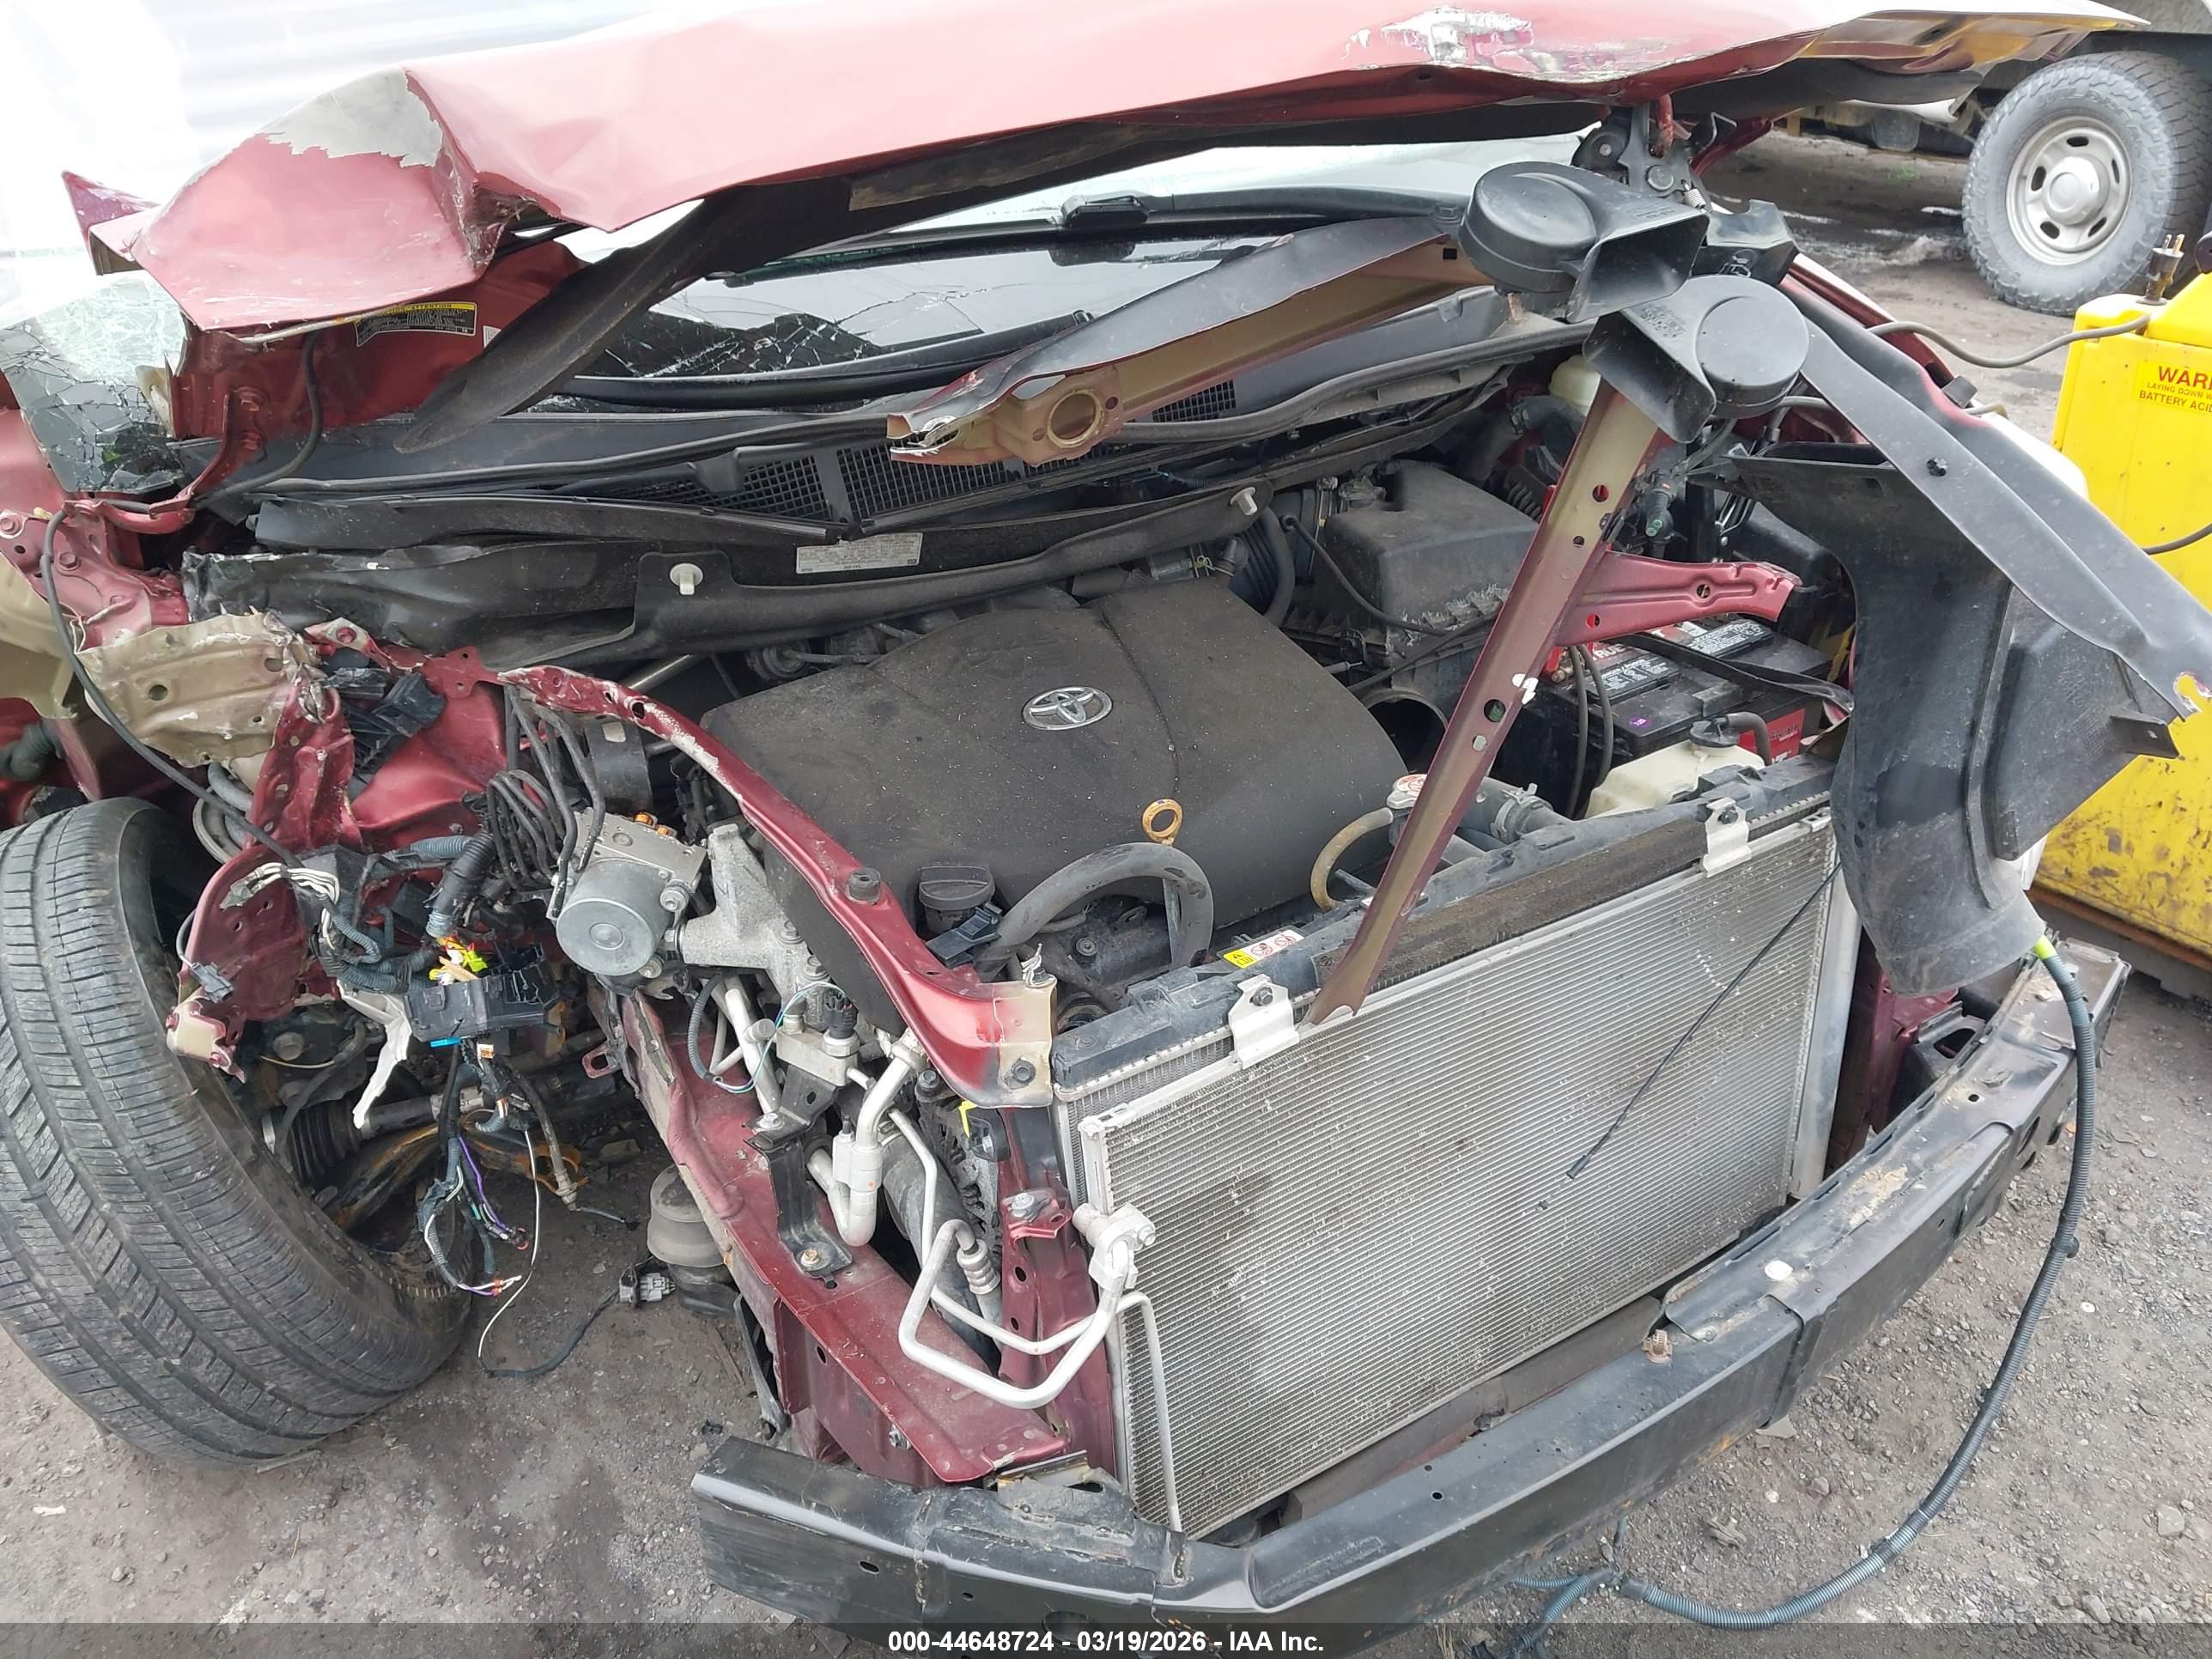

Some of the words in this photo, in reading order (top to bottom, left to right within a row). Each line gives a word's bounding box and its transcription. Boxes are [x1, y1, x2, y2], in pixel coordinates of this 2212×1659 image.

[2159, 366, 2212, 391] WAR
[2140, 390, 2188, 407] BATTERY
[2147, 382, 2176, 393] LAYING
[2179, 387, 2203, 398] DOWN
